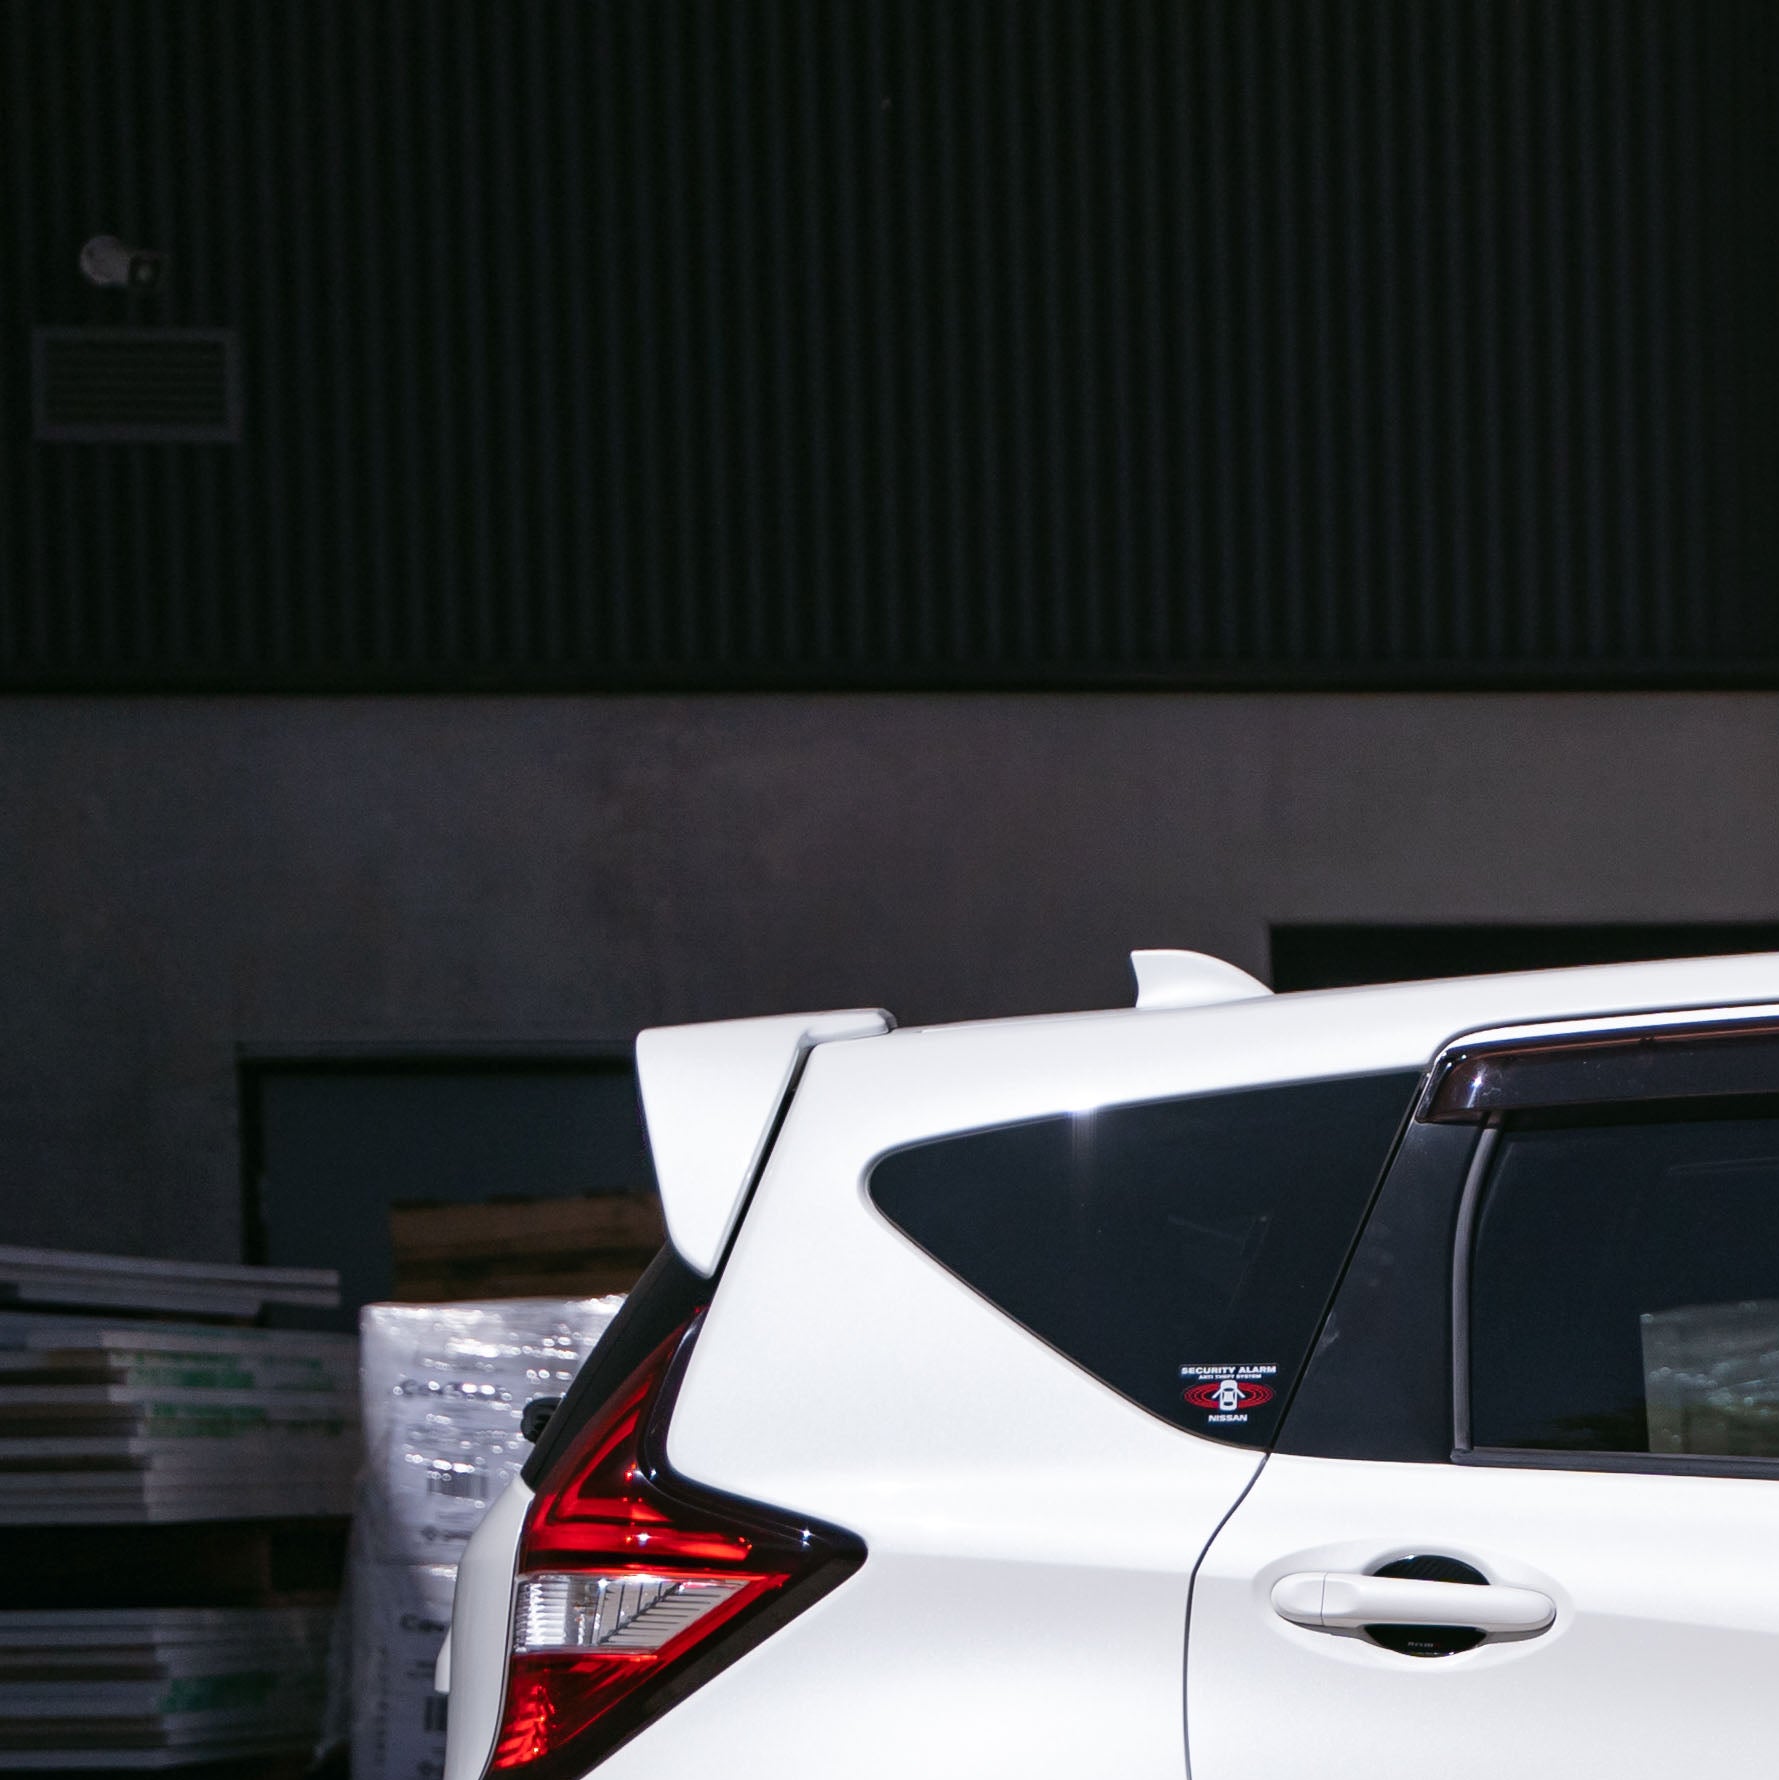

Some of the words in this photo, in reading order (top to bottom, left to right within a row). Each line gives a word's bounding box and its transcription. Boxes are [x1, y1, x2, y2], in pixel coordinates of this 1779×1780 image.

[1181, 1366, 1236, 1375] SECURITY
[1238, 1365, 1277, 1374] ALARM
[1208, 1413, 1249, 1422] NISSAN
